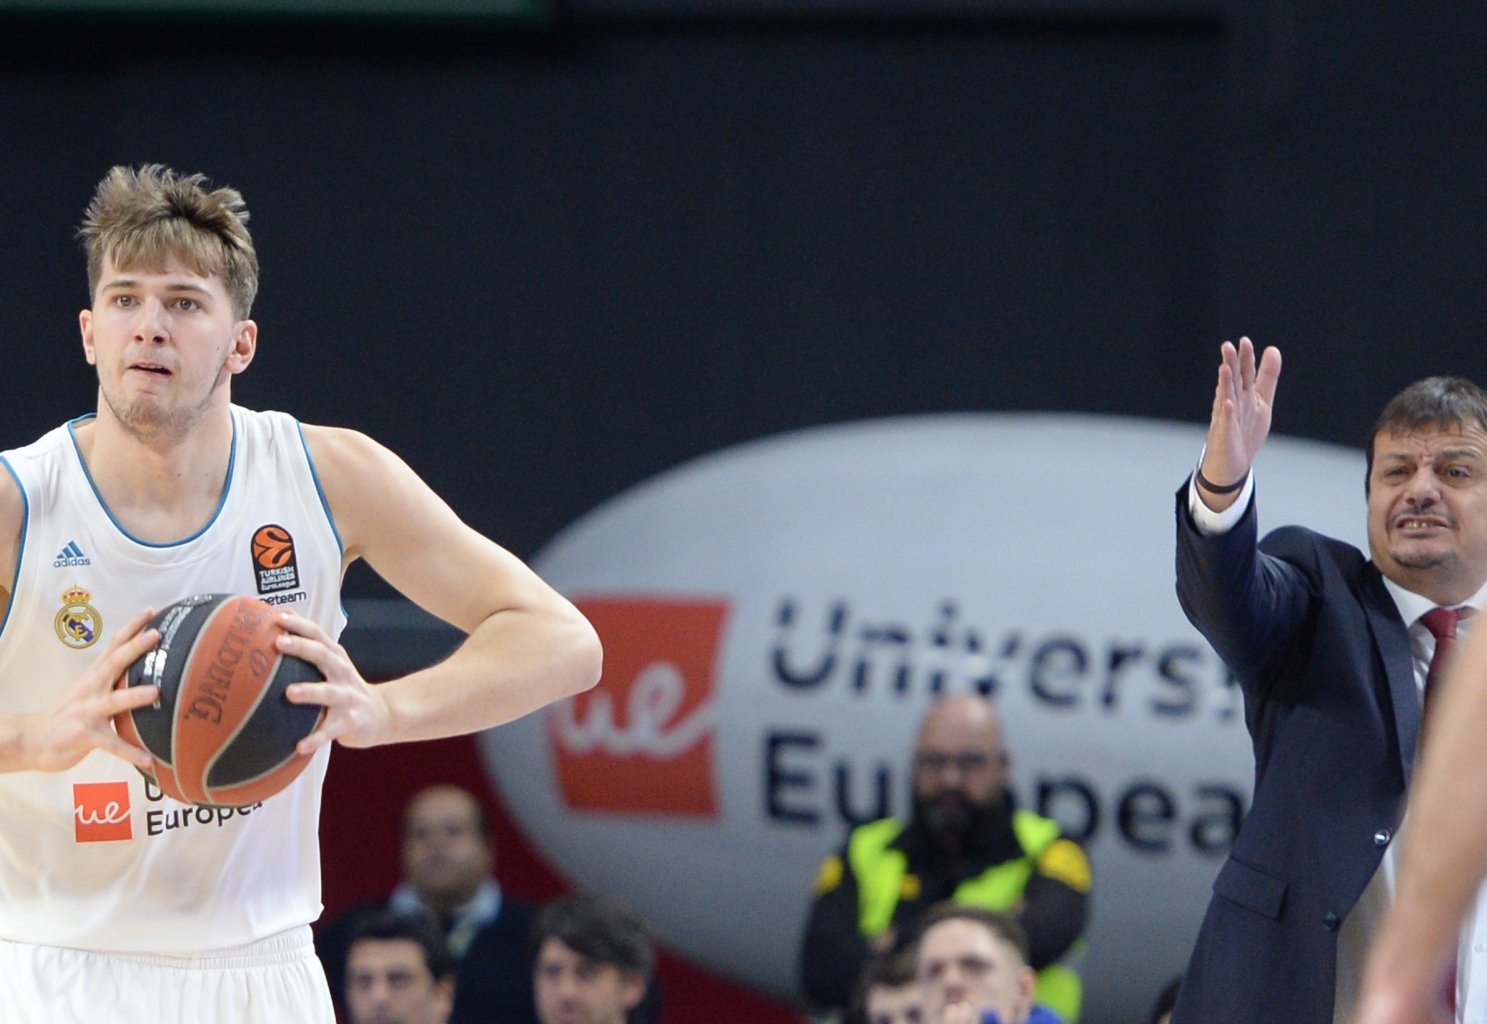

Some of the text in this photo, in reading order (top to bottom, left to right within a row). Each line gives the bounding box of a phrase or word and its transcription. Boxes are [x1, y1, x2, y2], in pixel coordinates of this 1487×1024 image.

[53, 557, 91, 568] adidas
[762, 728, 1246, 857] Eupea
[75, 801, 132, 825] ue
